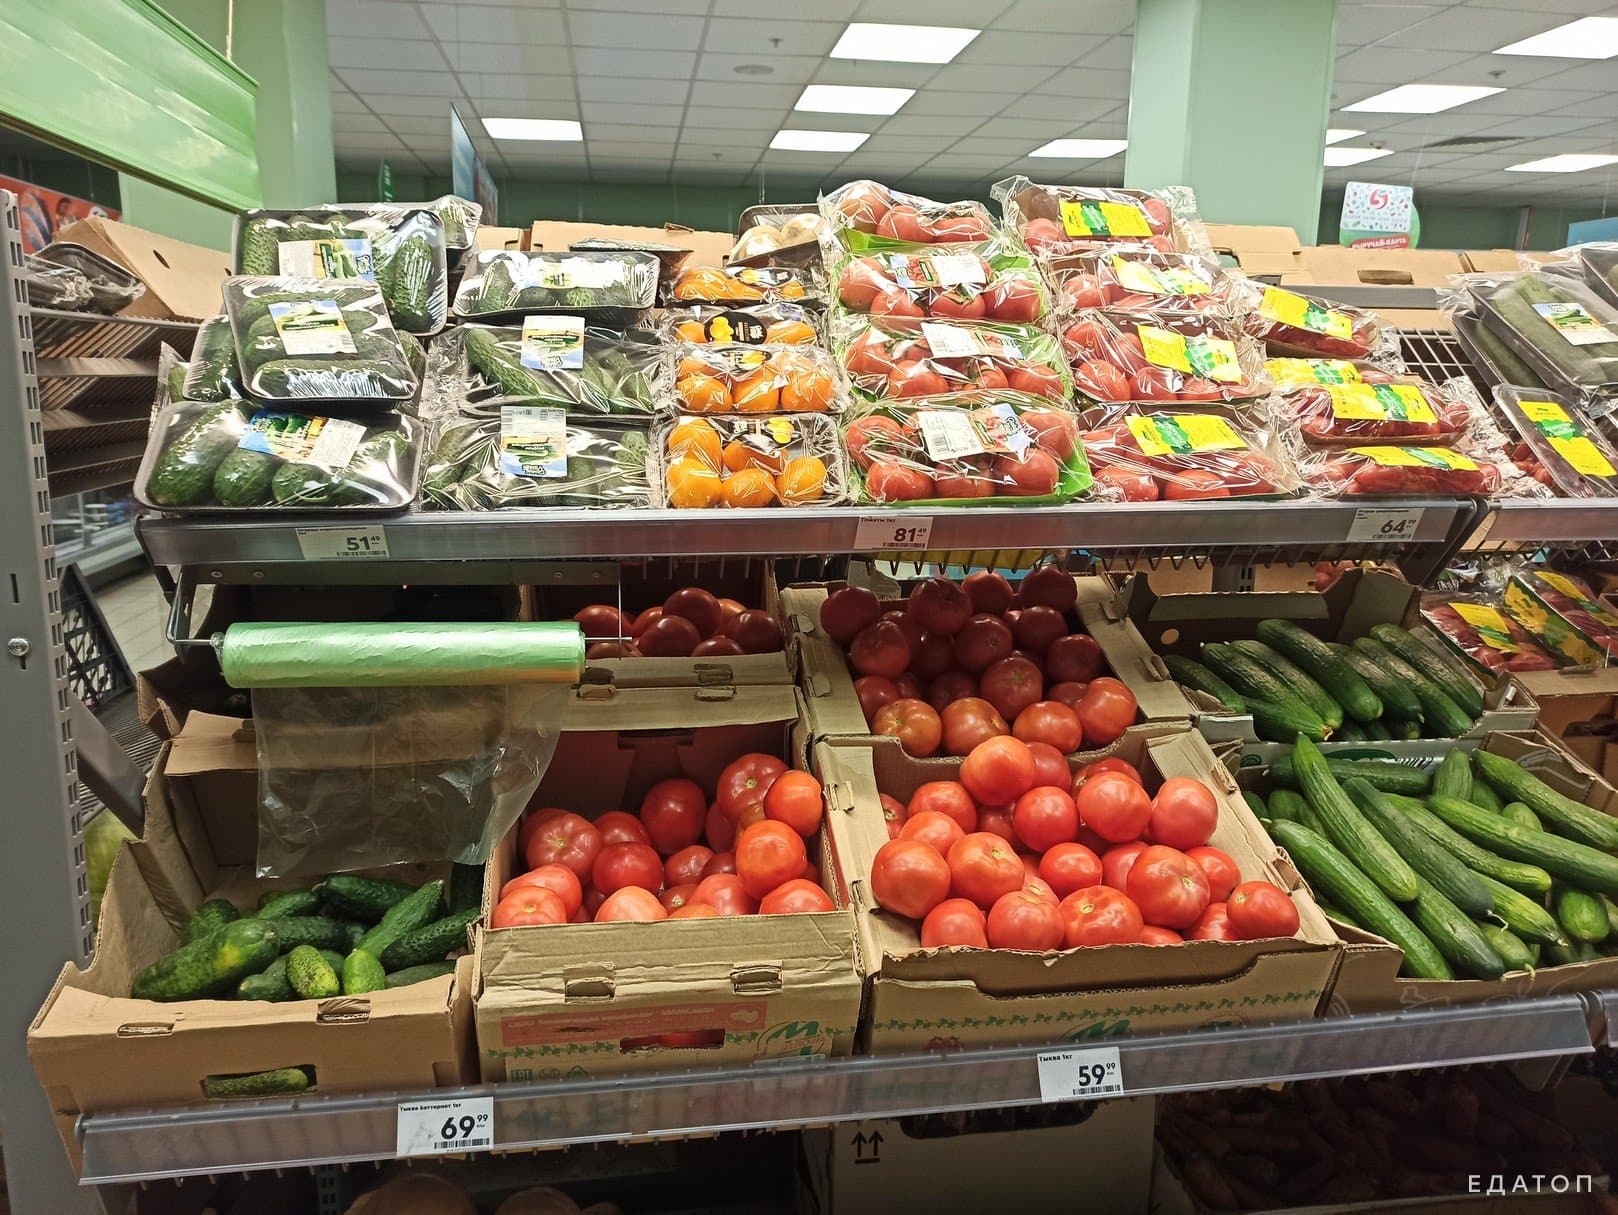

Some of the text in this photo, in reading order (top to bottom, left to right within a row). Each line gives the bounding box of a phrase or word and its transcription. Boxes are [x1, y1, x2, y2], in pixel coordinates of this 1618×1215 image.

[1381, 519, 1407, 534] 64
[894, 527, 917, 542] 81
[346, 536, 370, 551] 51
[1079, 1062, 1116, 1086] 59 99
[441, 1114, 488, 1140] 69 99
